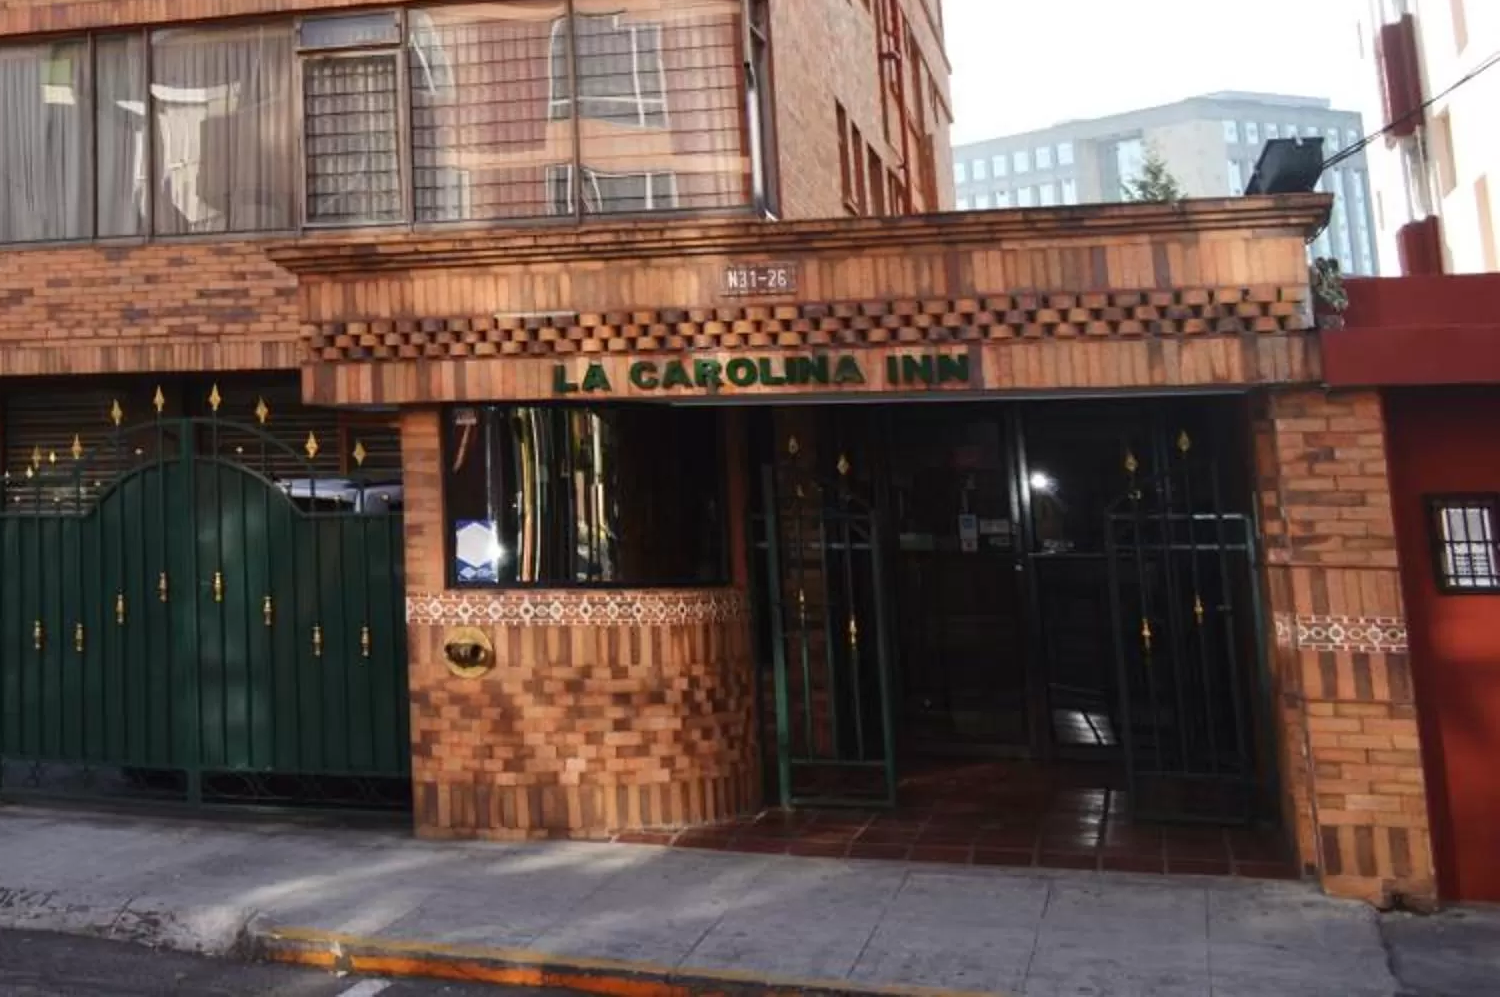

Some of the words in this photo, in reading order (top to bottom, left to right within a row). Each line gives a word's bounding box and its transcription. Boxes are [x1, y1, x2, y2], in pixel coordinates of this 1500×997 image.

[727, 268, 787, 288] N31-26
[553, 364, 612, 393] LA
[629, 354, 866, 391] CAROLINA
[886, 353, 969, 385] INN
